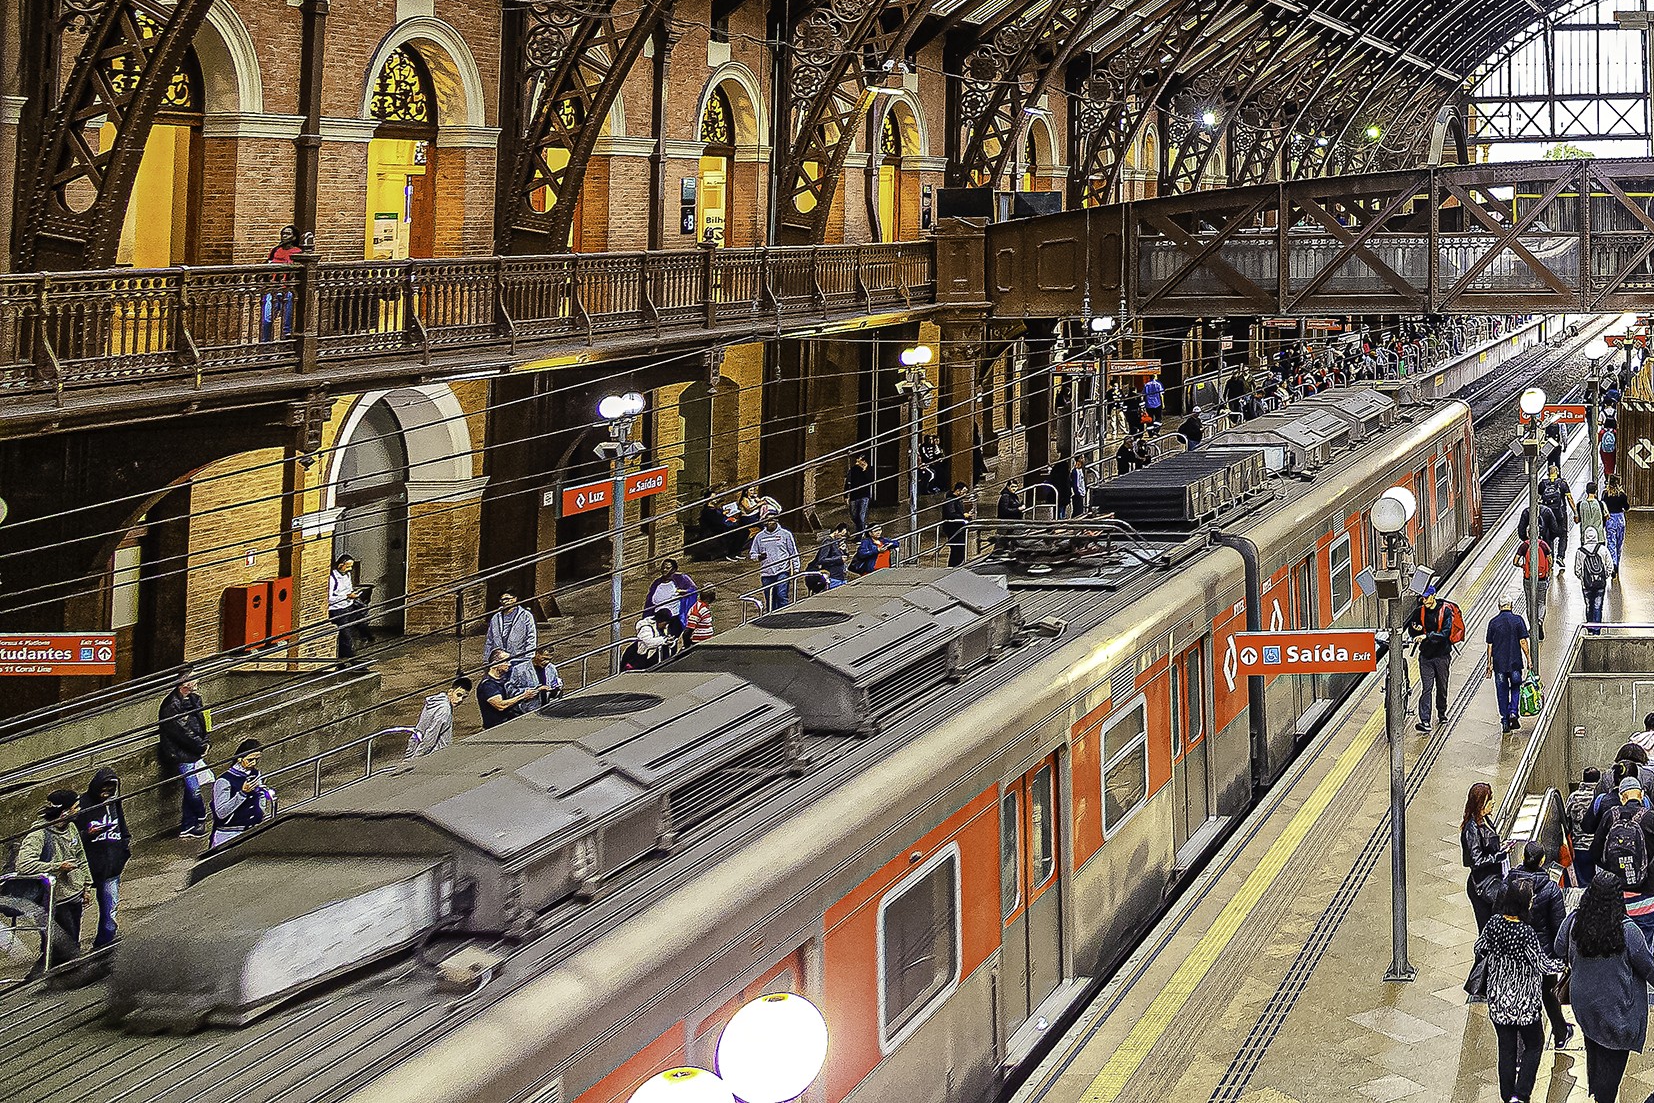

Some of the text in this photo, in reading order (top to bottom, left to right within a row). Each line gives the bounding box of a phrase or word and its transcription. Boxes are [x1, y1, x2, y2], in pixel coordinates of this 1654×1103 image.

[588, 491, 604, 504] Luz
[1286, 643, 1371, 663] Saída Exit
